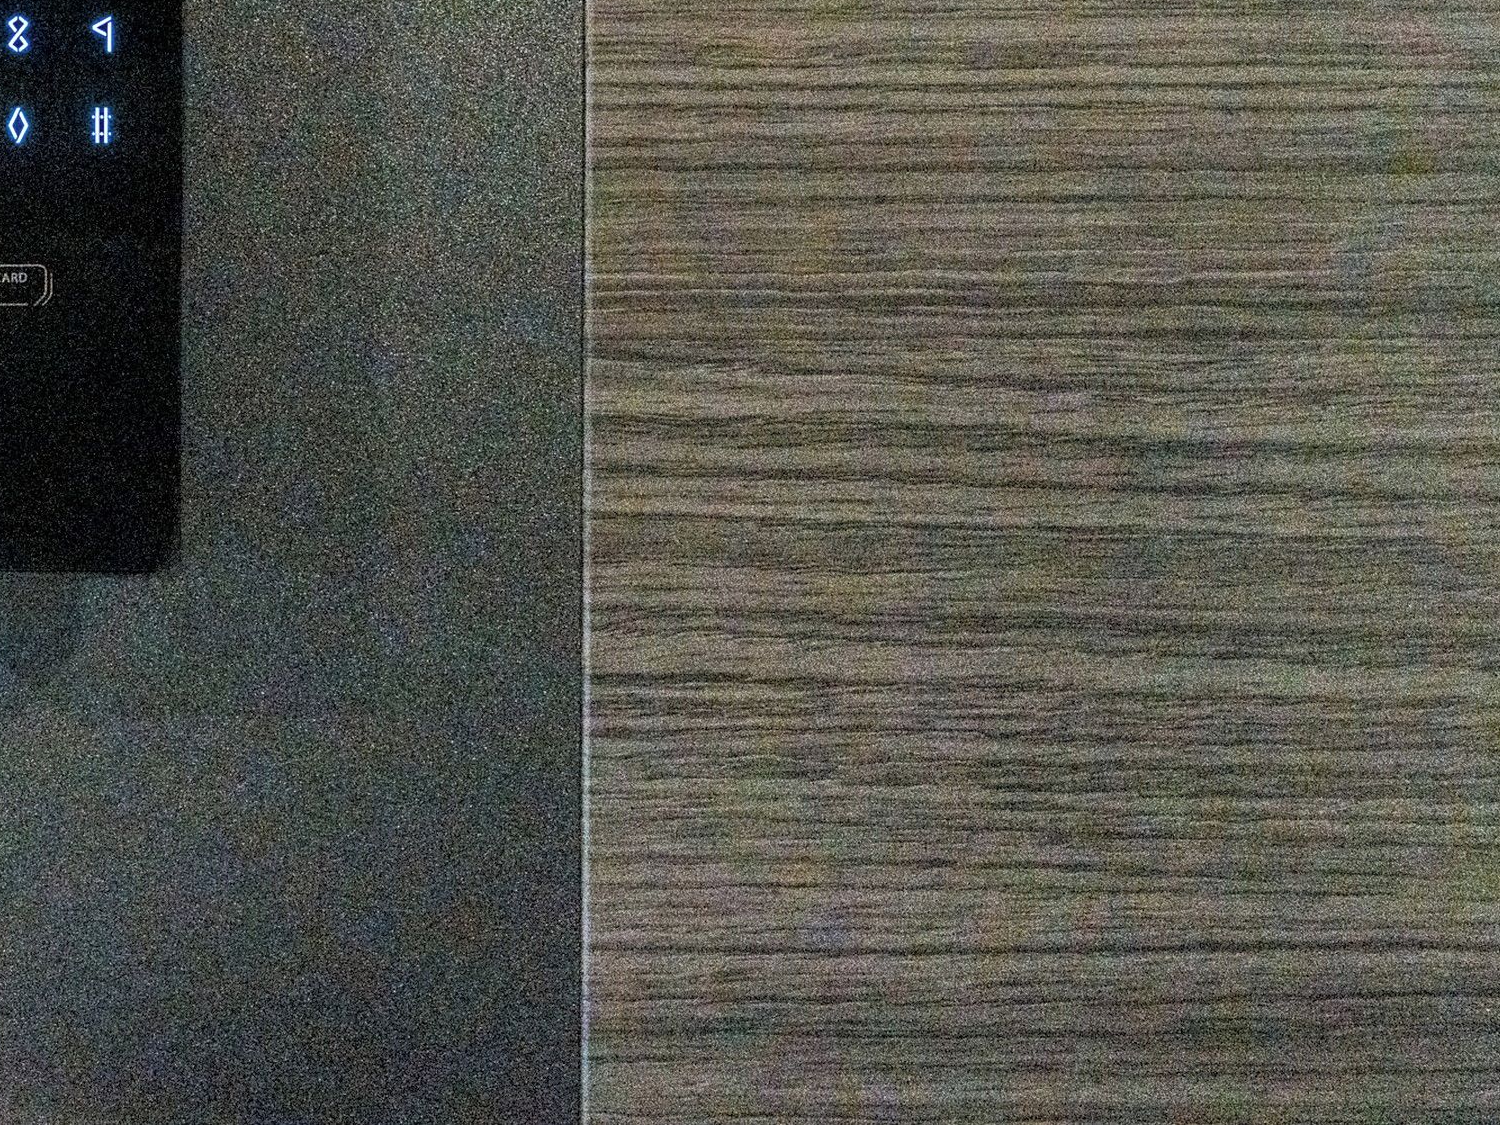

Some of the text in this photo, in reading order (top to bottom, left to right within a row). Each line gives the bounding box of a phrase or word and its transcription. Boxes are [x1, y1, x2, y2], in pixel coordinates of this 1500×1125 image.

[6, 15, 31, 53] 8
[91, 16, 115, 53] 9
[7, 107, 30, 145] 0
